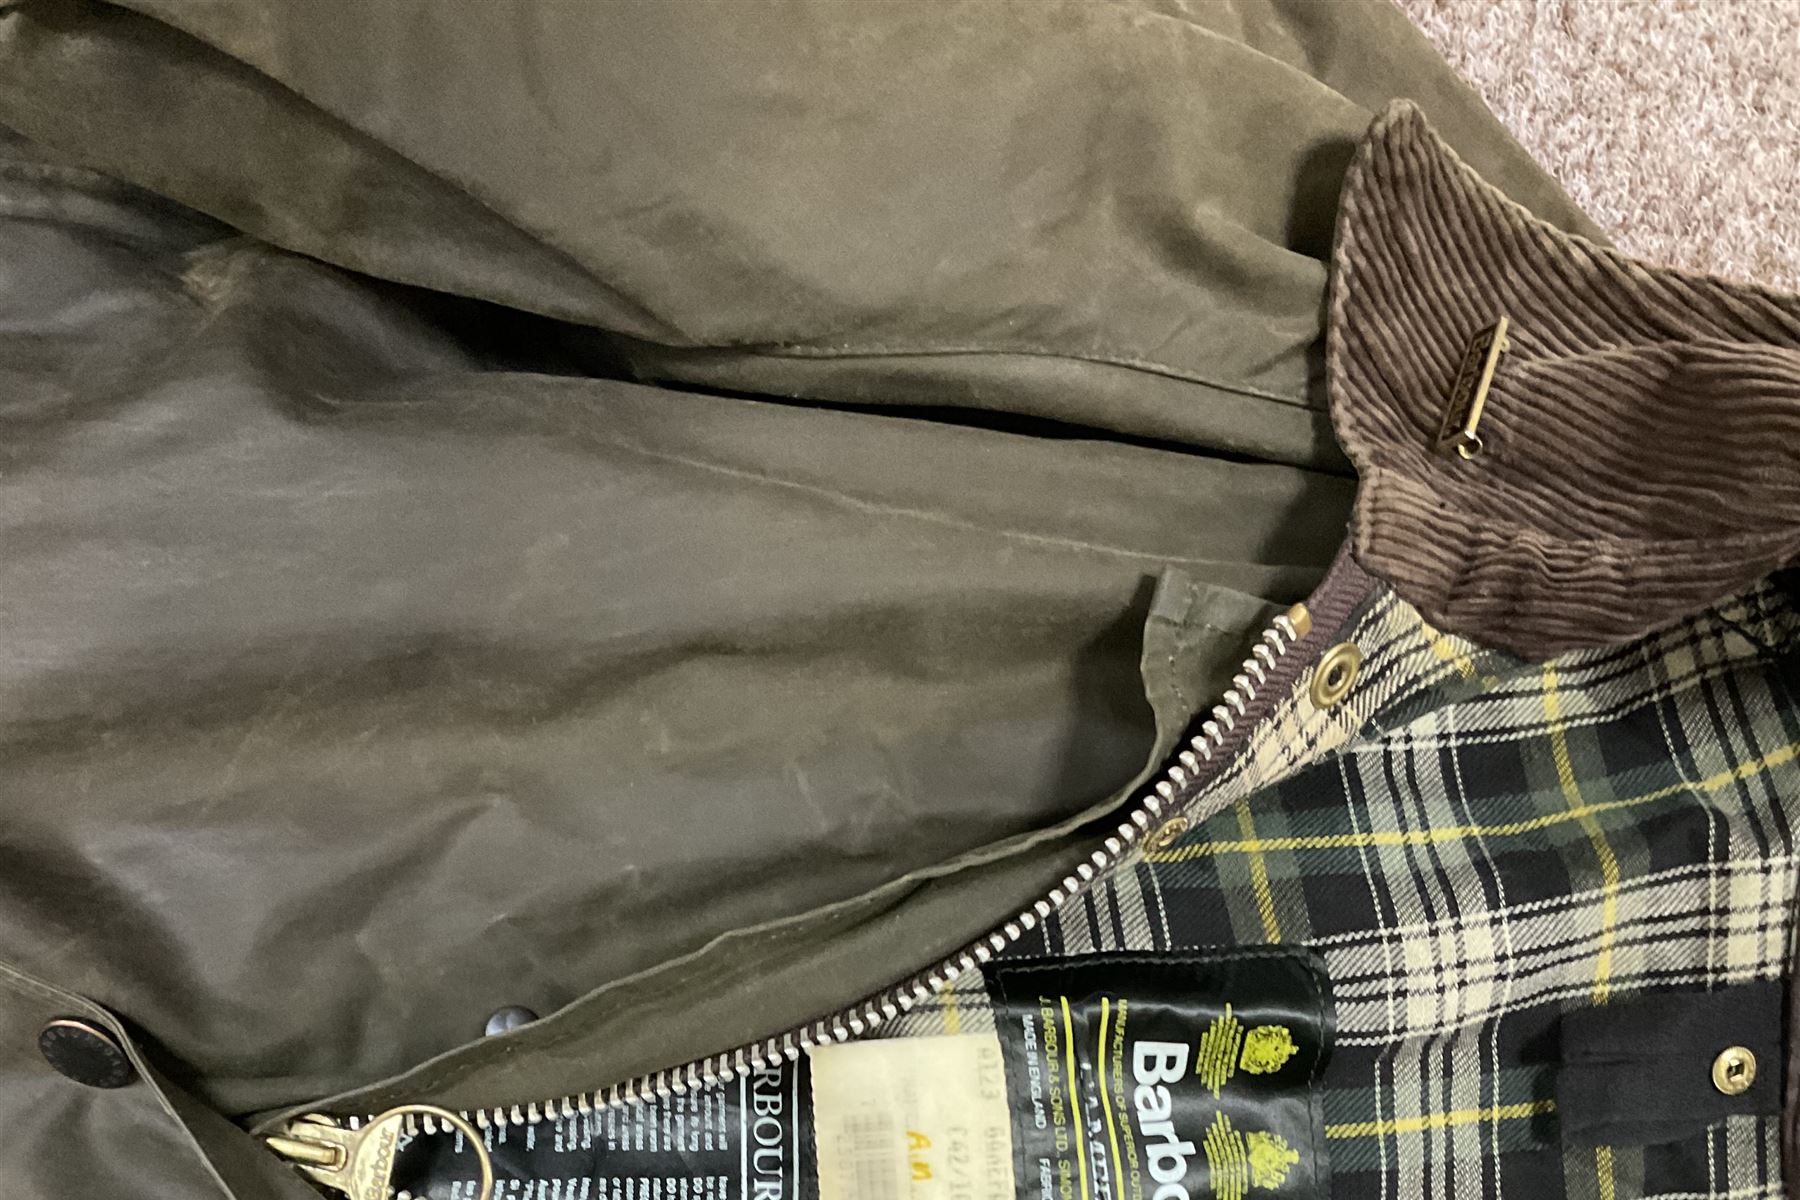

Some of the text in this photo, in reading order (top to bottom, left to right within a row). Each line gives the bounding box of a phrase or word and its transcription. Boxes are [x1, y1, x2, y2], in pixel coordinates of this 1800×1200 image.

[1040, 1007, 1060, 1072] BARBOUR
[1112, 999, 1128, 1094] MANUFACTURERS
[1022, 1014, 1047, 1129] MADE IN ENGLAND
[1048, 1074, 1060, 1084] &
[1049, 1086, 1066, 1126] SONS
[1116, 1095, 1131, 1111] OF
[1118, 1112, 1139, 1169] SUPERIOR
[666, 1177, 677, 1194] DO
[693, 1177, 703, 1194] DO
